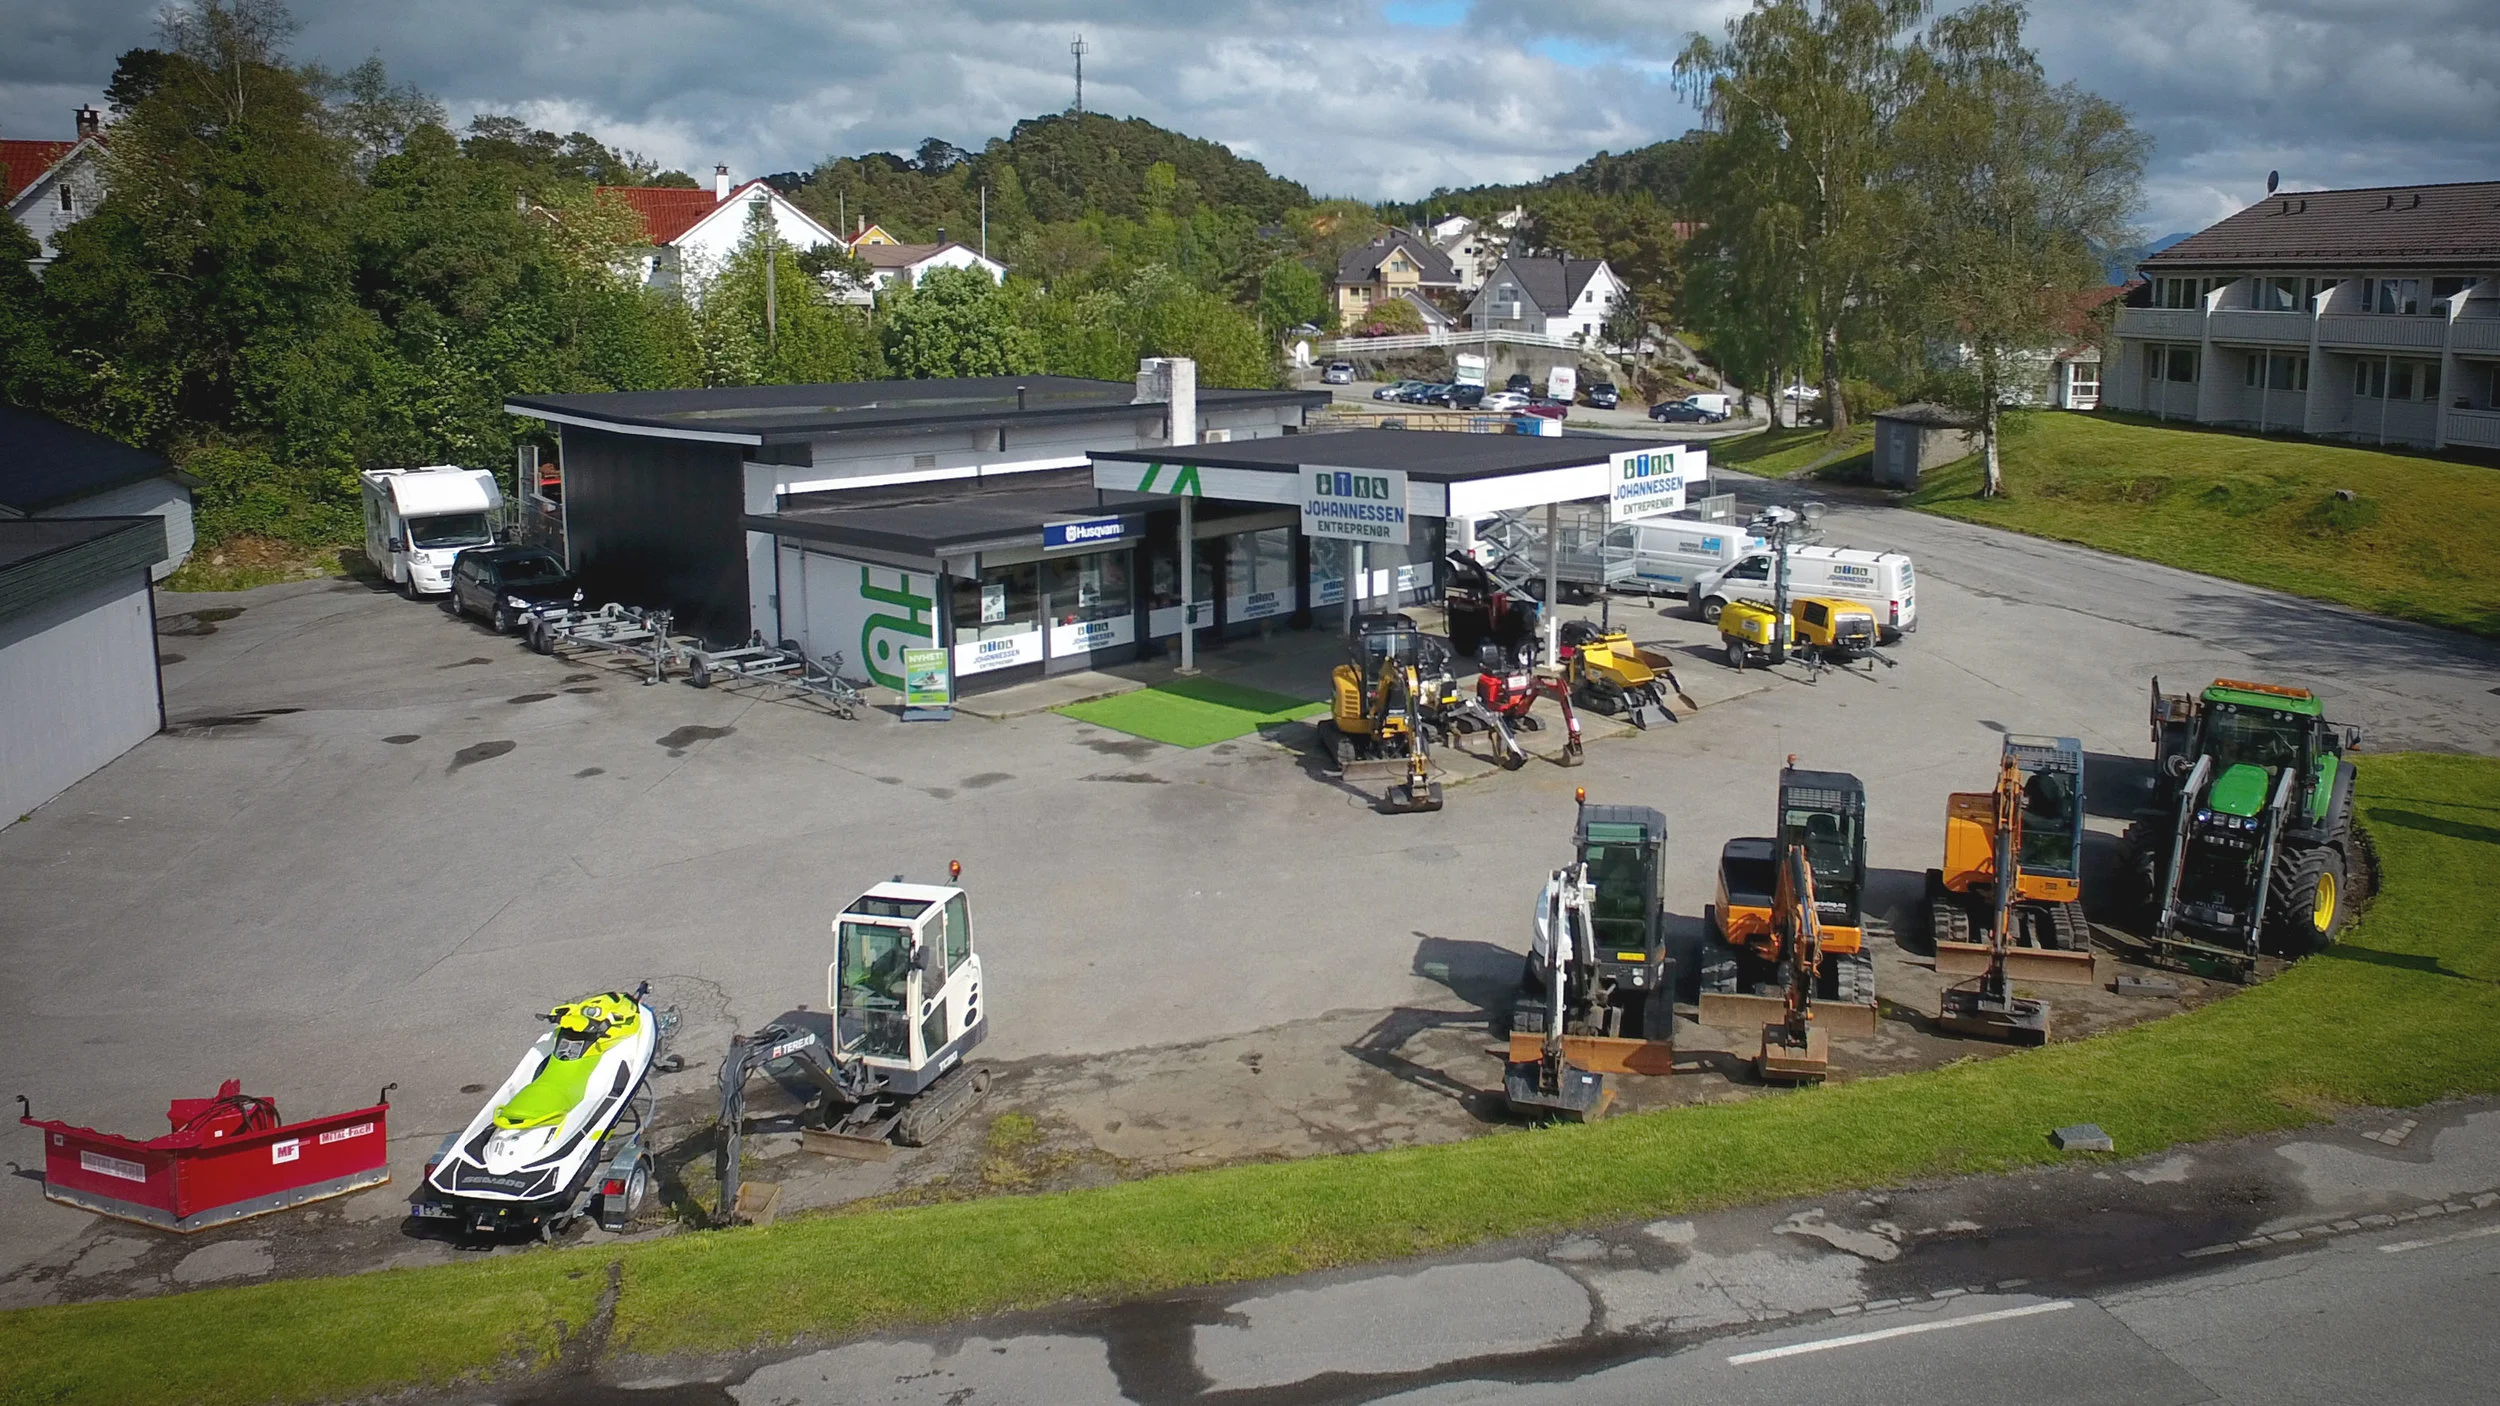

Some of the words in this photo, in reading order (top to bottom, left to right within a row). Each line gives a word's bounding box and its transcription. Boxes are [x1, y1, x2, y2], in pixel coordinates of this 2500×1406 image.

[1613, 476, 1684, 501] JOHANNESSEN
[1304, 500, 1405, 523] JOHANNESSEN
[1623, 497, 1674, 515] ENTREPRENØR
[1076, 524, 1125, 539] Husqvarna
[1317, 520, 1391, 538] ENTREPRENØR
[908, 652, 944, 663] NYHET!
[782, 1035, 809, 1055] TEREX
[277, 1146, 295, 1158] MF
